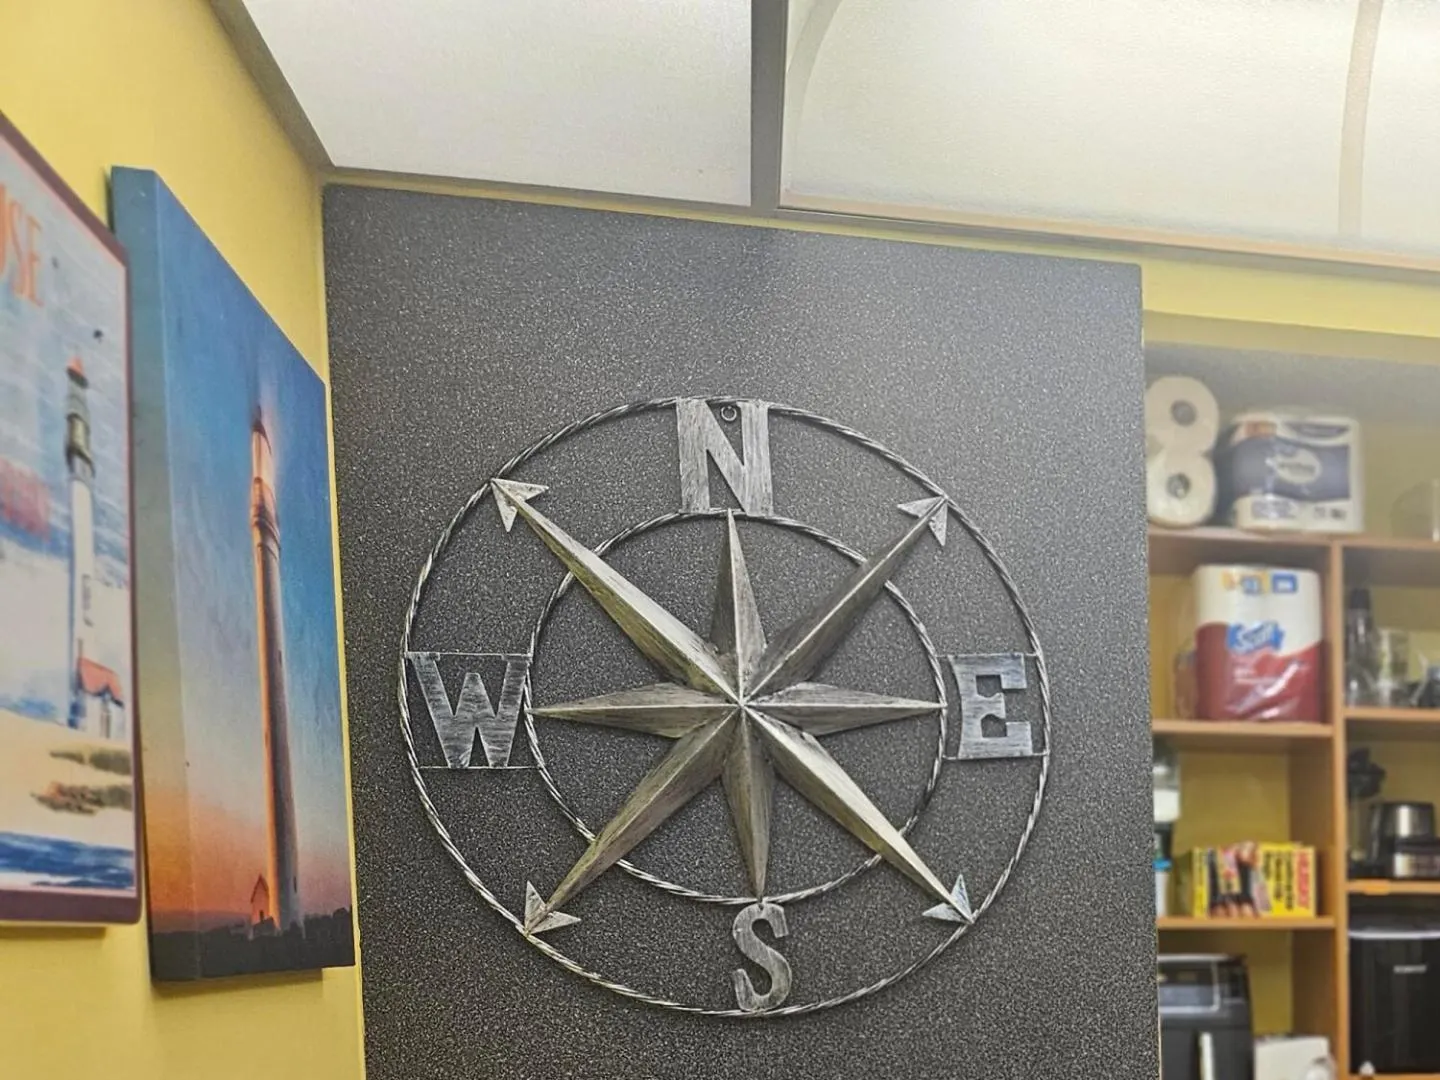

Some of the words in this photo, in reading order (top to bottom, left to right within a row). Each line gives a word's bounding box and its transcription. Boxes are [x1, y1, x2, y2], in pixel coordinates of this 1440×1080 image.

[676, 398, 773, 517] N
[406, 652, 530, 768] W
[947, 653, 1035, 759] E
[732, 902, 793, 1012] S
